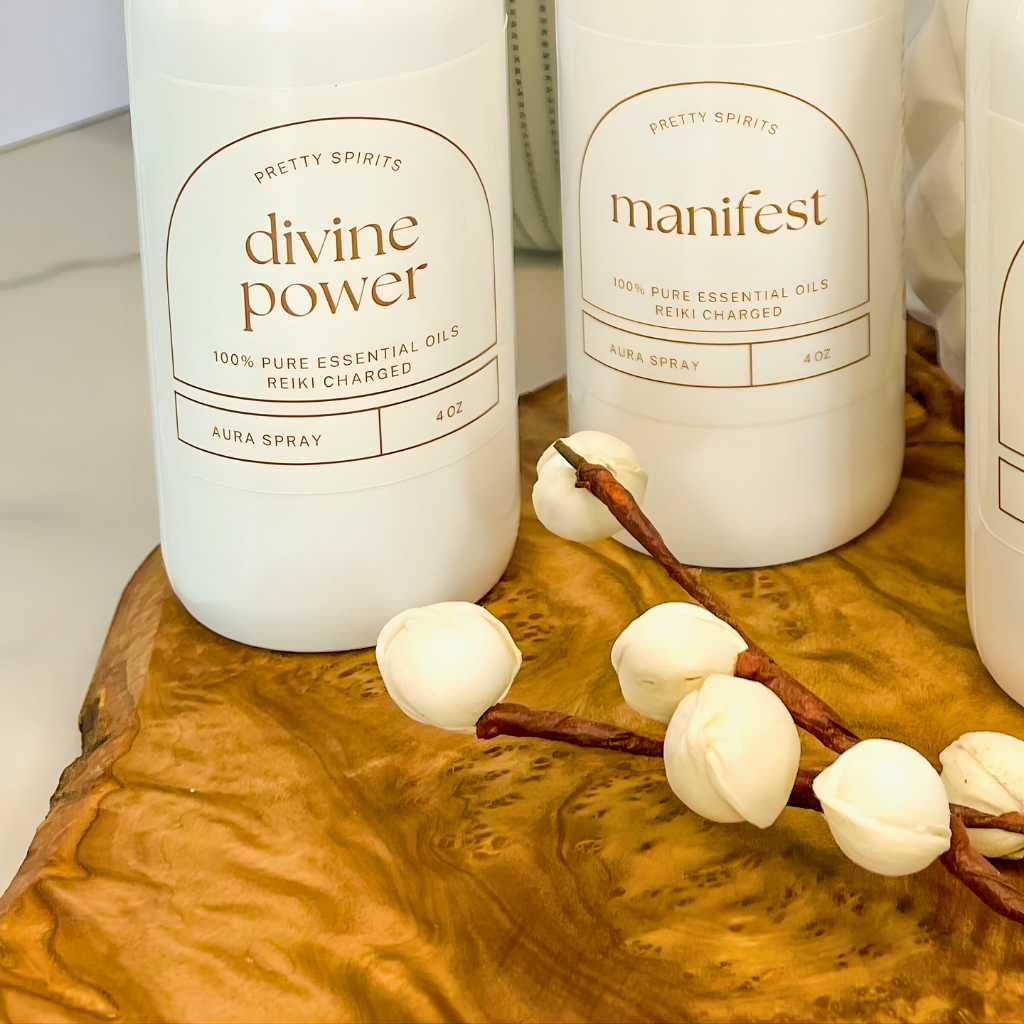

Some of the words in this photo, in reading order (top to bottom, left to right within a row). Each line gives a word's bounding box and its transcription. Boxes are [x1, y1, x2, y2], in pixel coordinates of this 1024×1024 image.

[648, 111, 708, 136] PRETTY
[714, 110, 779, 136] SPIRITS
[253, 152, 323, 185] PRETTY
[330, 150, 403, 173] SPIRITS
[609, 188, 829, 237] manifest
[244, 211, 420, 265] divine
[240, 262, 429, 333] power
[612, 276, 646, 296] 100%
[651, 285, 691, 302] PURE
[697, 286, 789, 304] ESSENTIAL
[794, 278, 830, 297] OILS
[655, 304, 696, 320] REIKI
[702, 305, 783, 321] CHARGED
[212, 350, 255, 369] 100%
[261, 356, 310, 370] PURE
[317, 341, 419, 370] ESSENTIAL
[424, 324, 460, 348] OILS
[609, 342, 645, 364] AURA
[649, 354, 701, 372] SPRAY
[266, 375, 316, 390] REIKI
[322, 361, 412, 389] CHARGED
[211, 425, 256, 446] AURA
[261, 433, 323, 448] SPRAY
